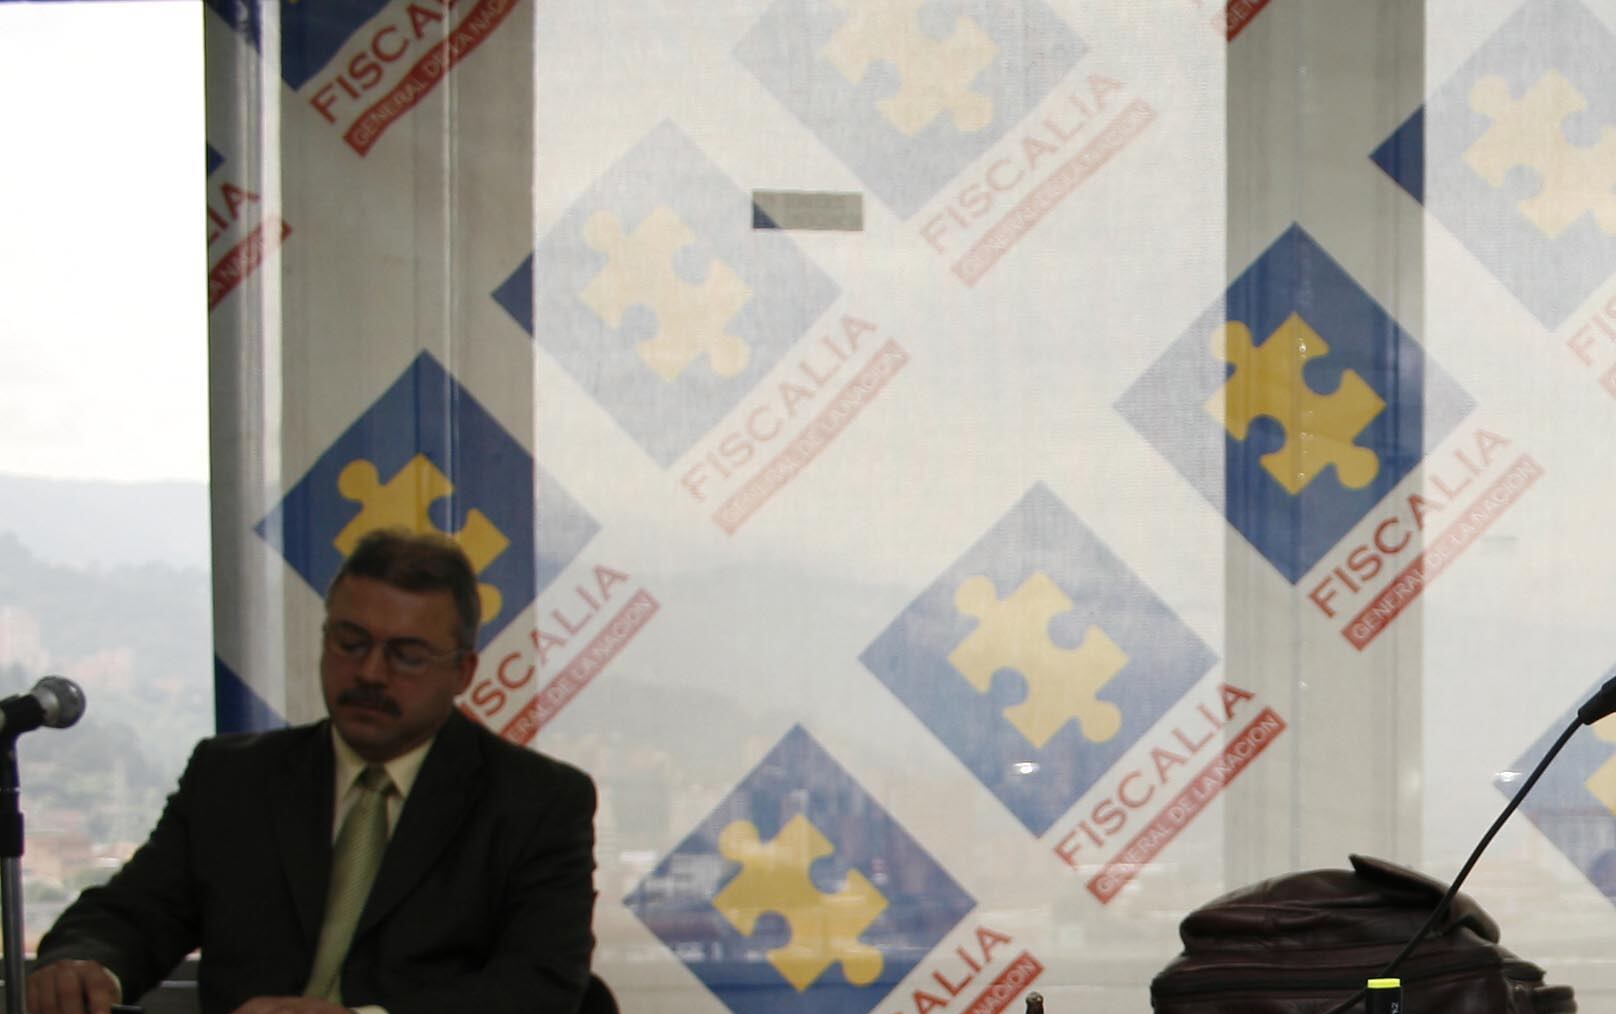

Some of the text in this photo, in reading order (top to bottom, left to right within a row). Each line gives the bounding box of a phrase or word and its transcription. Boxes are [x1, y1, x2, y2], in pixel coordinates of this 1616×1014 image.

[919, 72, 1127, 255] FISCALIA
[681, 314, 880, 503] FISCALIA
[1308, 429, 1512, 619] FISCALIA
[1348, 564, 1431, 645] GENERAL
[1053, 682, 1255, 871] FISCALIA
[1165, 795, 1197, 827] DE
[1190, 773, 1220, 802] LA
[1209, 713, 1280, 783] NACION
